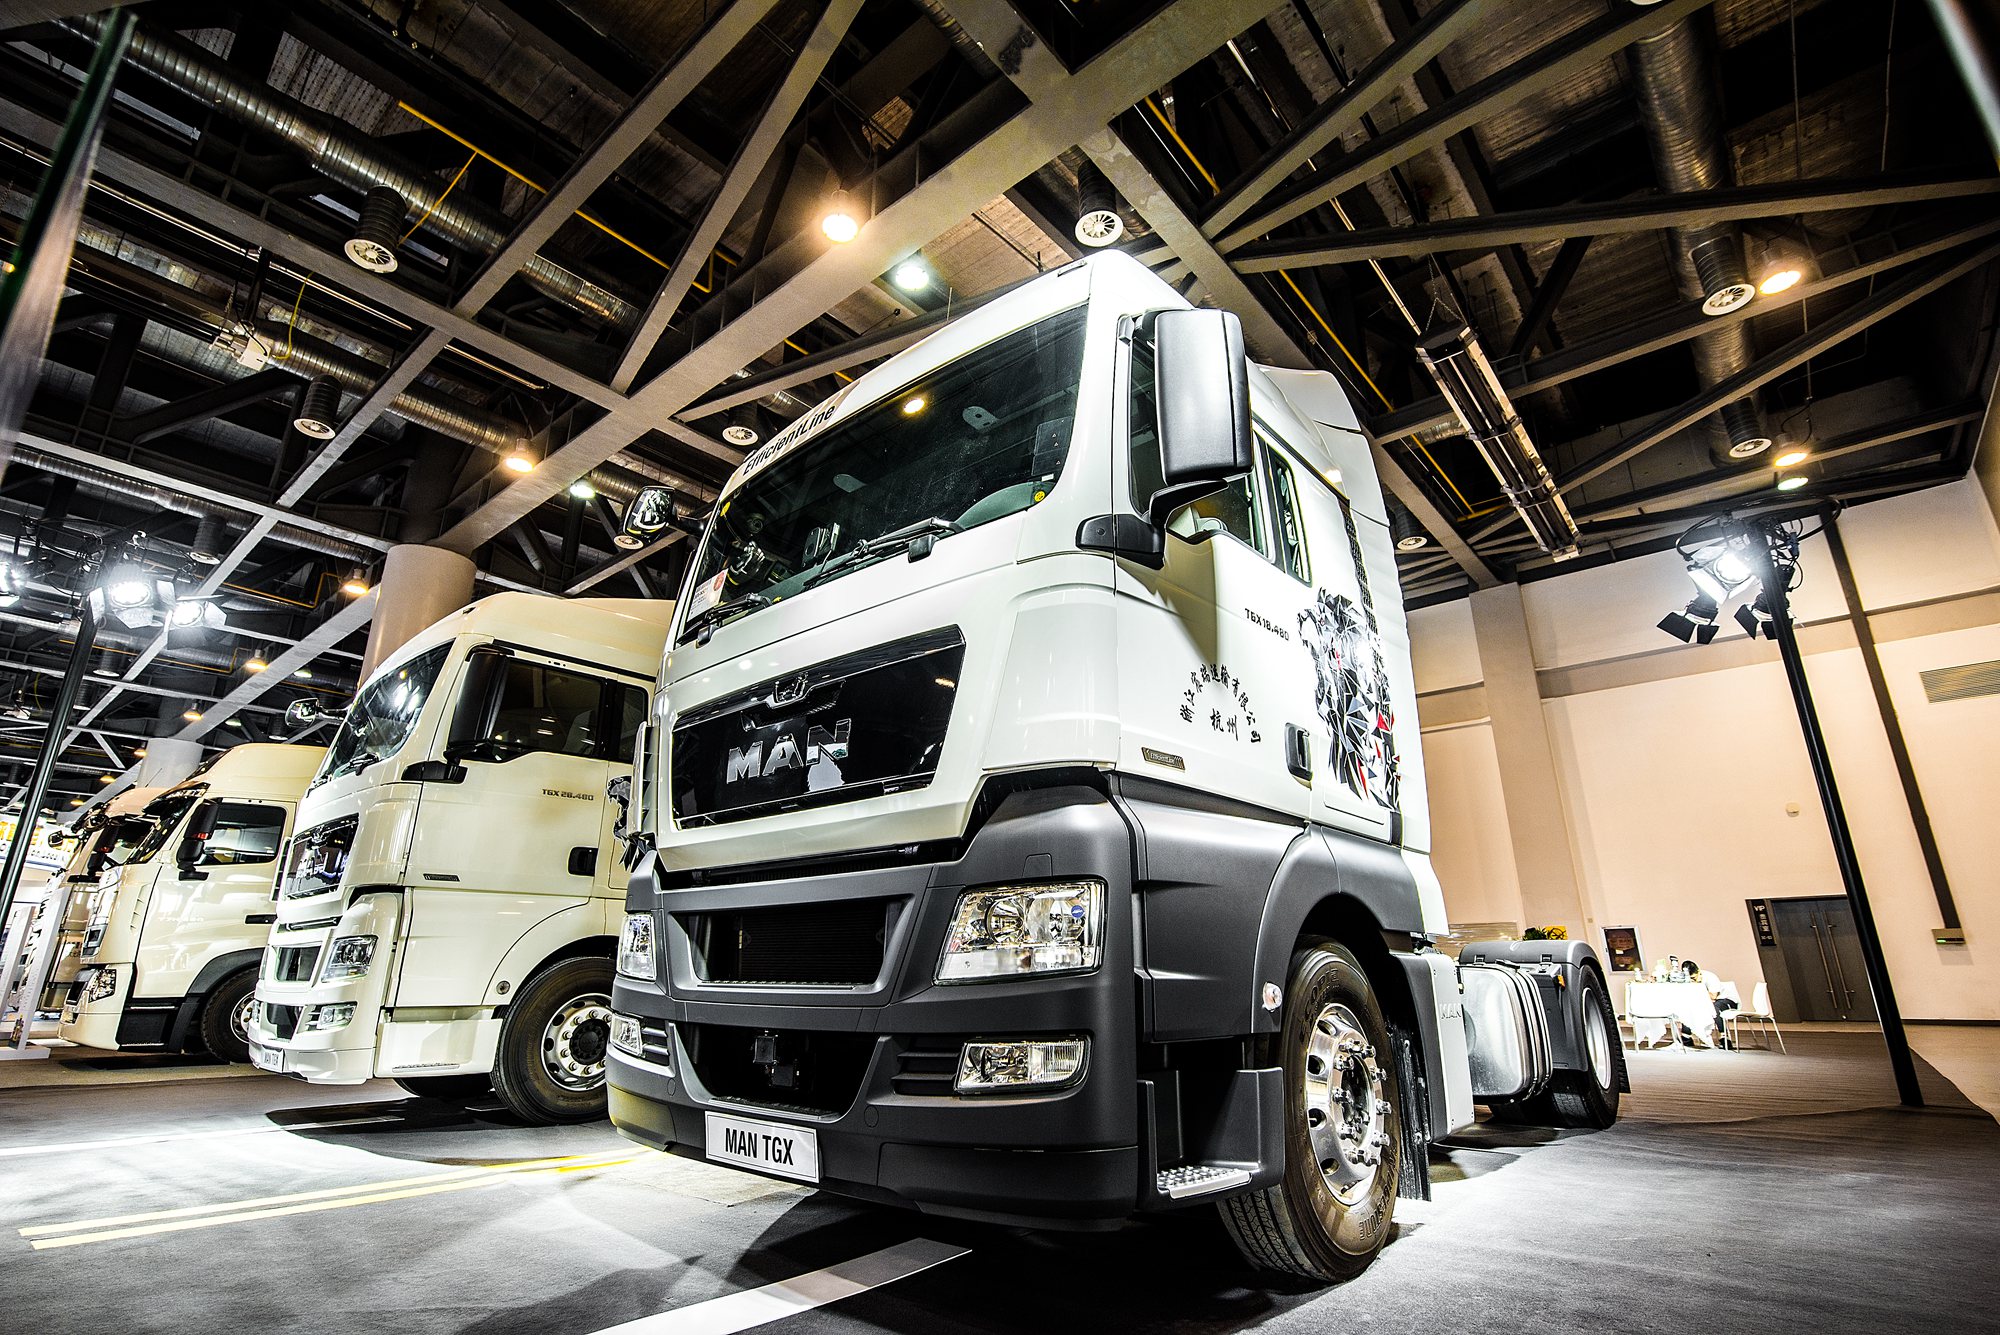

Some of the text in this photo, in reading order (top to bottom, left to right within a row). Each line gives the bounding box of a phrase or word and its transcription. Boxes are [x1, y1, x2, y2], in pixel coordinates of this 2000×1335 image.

[743, 405, 835, 476] EfficientLine
[1210, 708, 1239, 741] 杭州
[726, 718, 852, 785] MAN
[542, 788, 560, 797] TGX
[725, 1127, 794, 1166] MAN TGX
